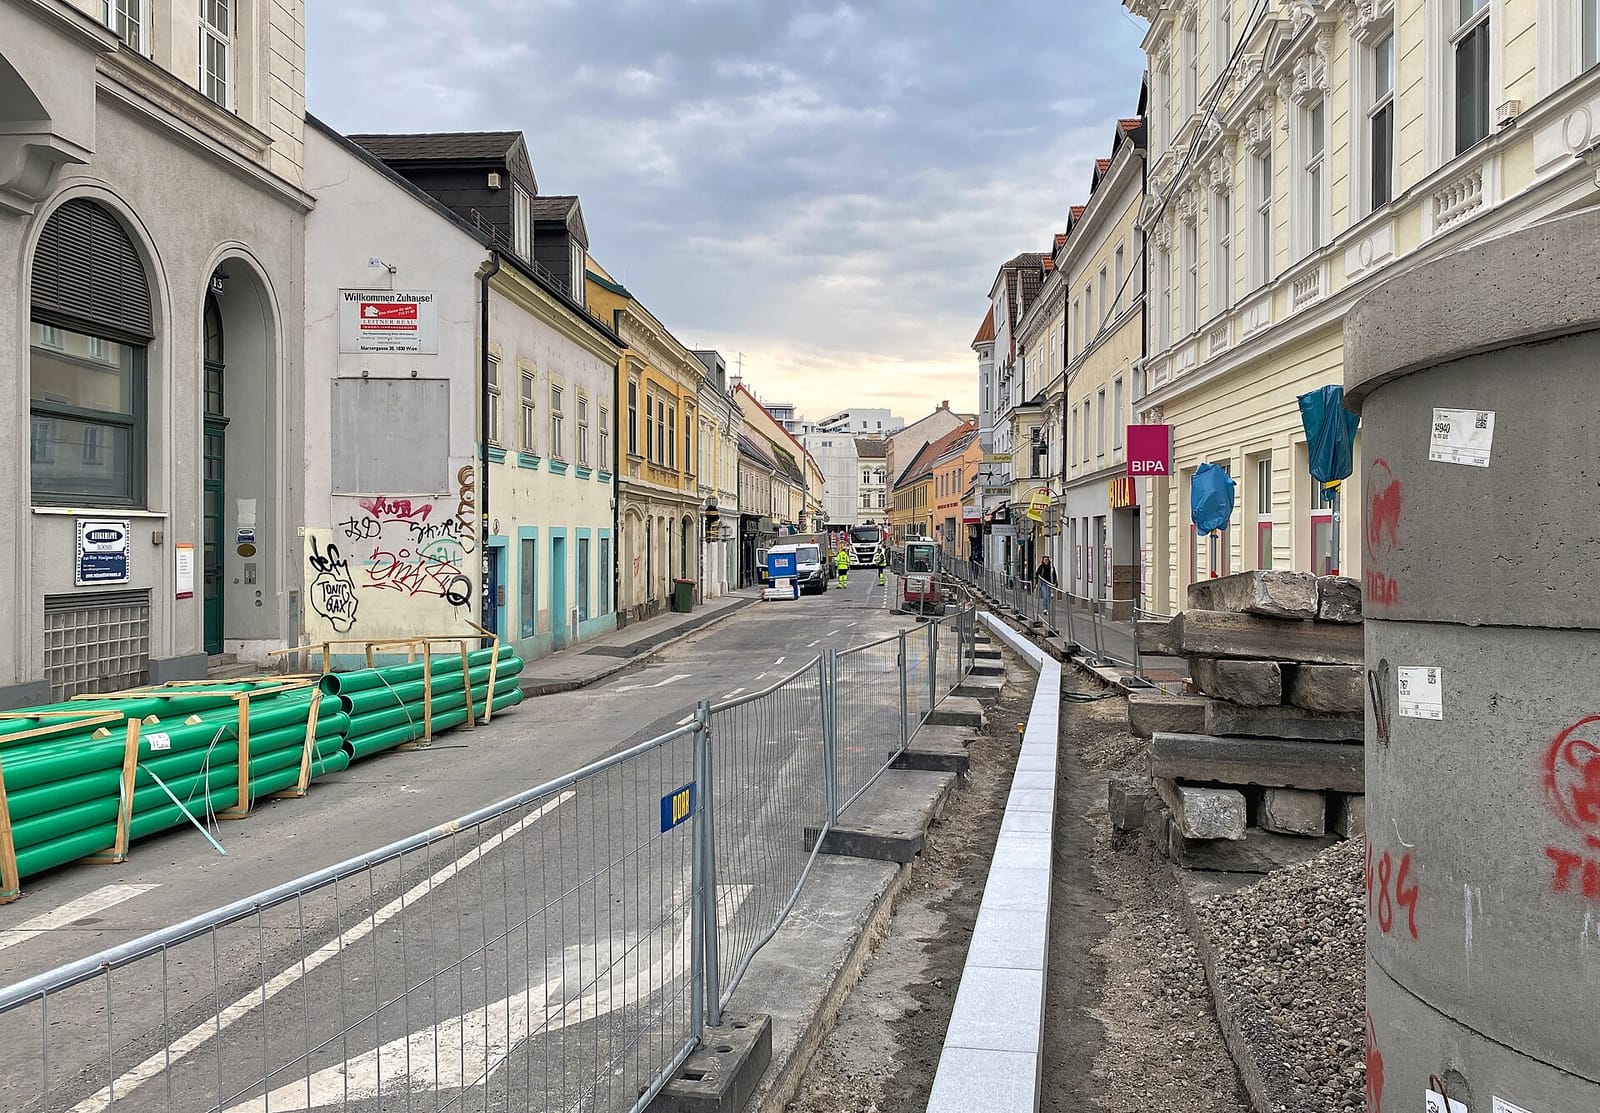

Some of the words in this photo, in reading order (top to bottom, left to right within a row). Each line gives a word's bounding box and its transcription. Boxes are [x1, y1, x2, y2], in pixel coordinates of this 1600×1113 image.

[213, 276, 223, 289] 13
[344, 292, 395, 303] Willkommen
[396, 293, 433, 304] Zuhause!
[1131, 460, 1165, 472] BIPA
[1109, 476, 1130, 509] BILLA
